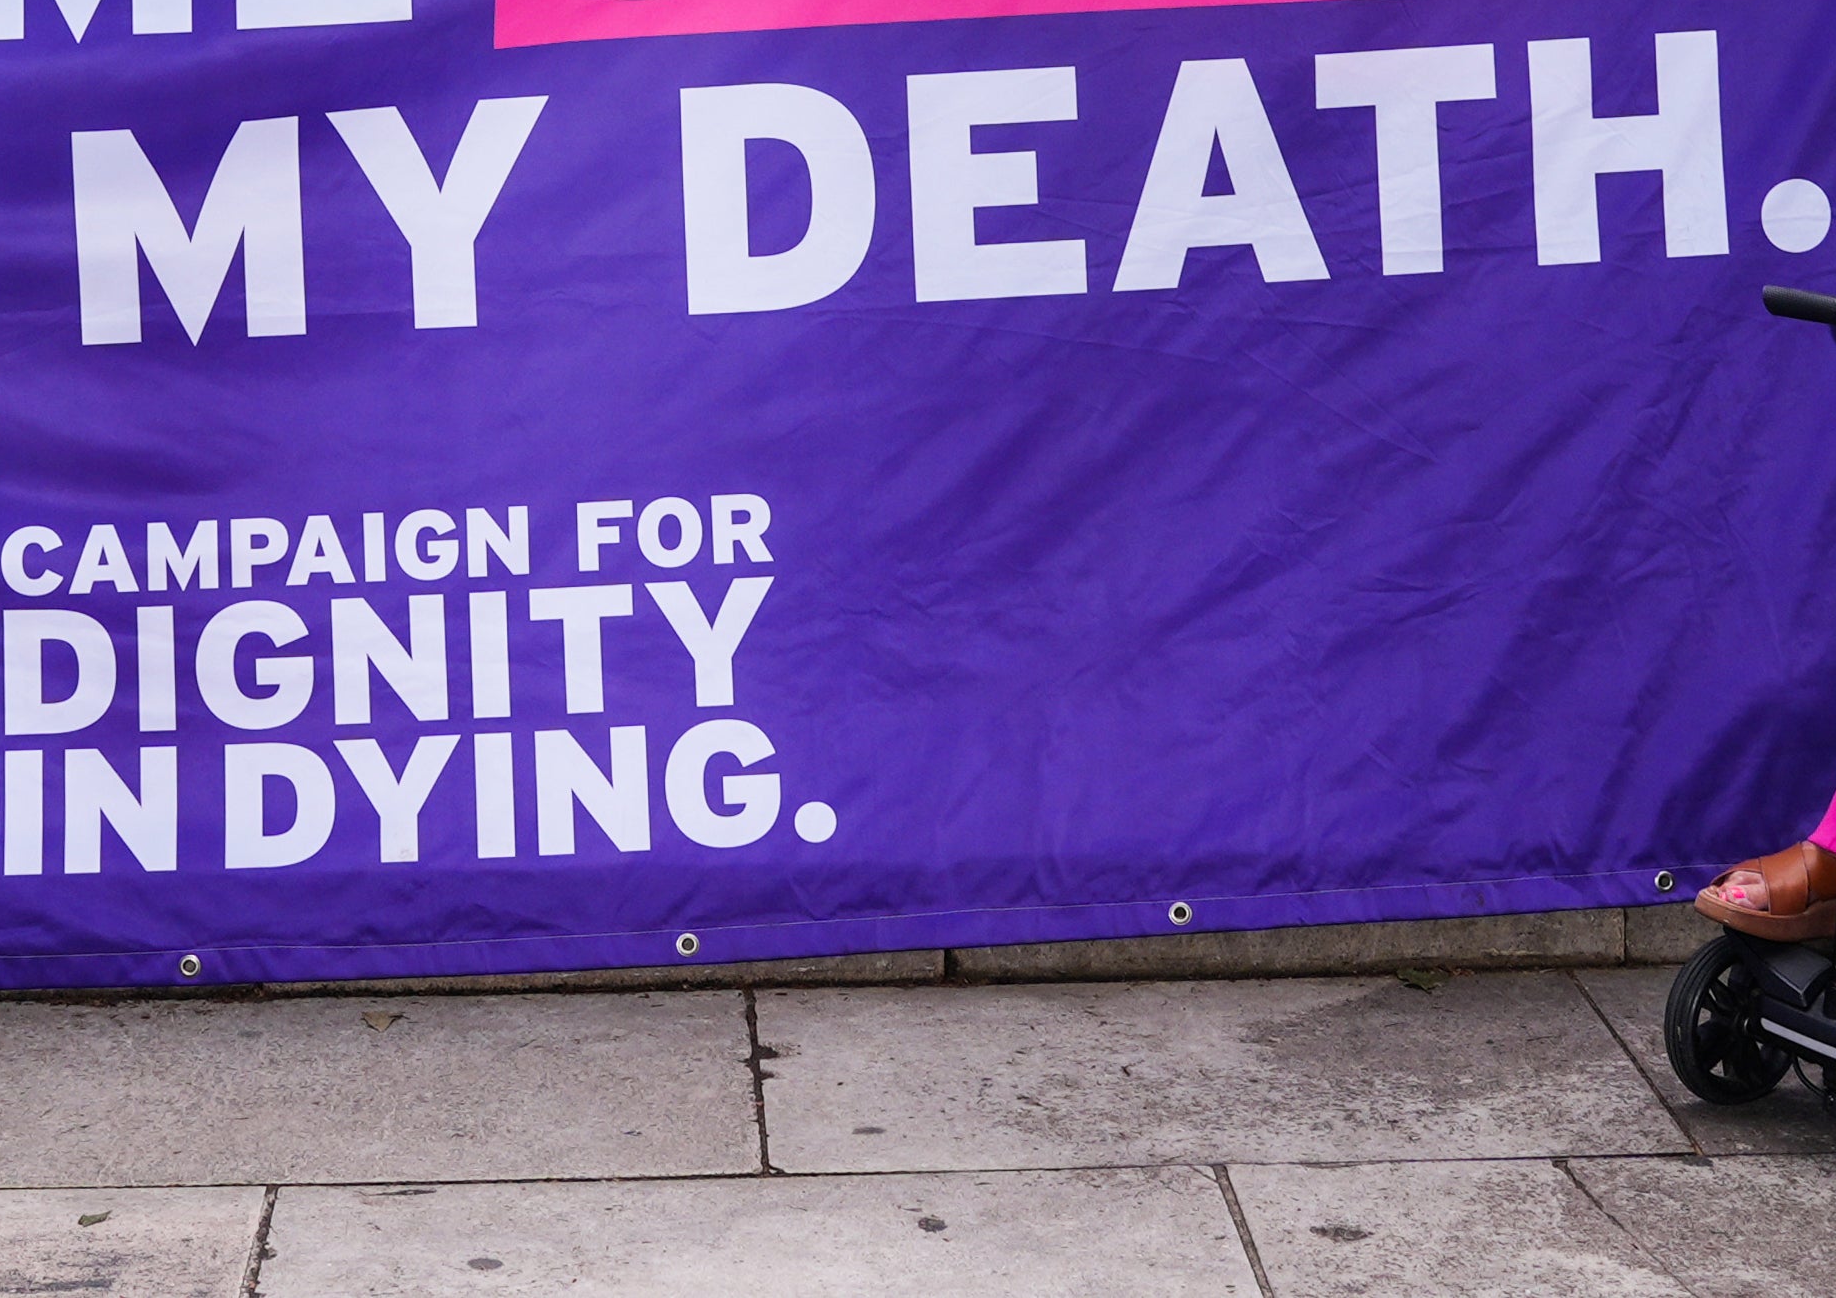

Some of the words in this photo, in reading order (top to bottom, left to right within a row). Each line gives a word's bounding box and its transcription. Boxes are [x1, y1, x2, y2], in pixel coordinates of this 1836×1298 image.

[71, 95, 549, 346] MY
[679, 30, 1831, 315] DEATH.
[0, 505, 530, 596] CAMPAIGN
[576, 493, 774, 572] FOR
[3, 576, 775, 736] DIGNITY
[4, 746, 178, 876] IN
[224, 719, 837, 869] DYING.
